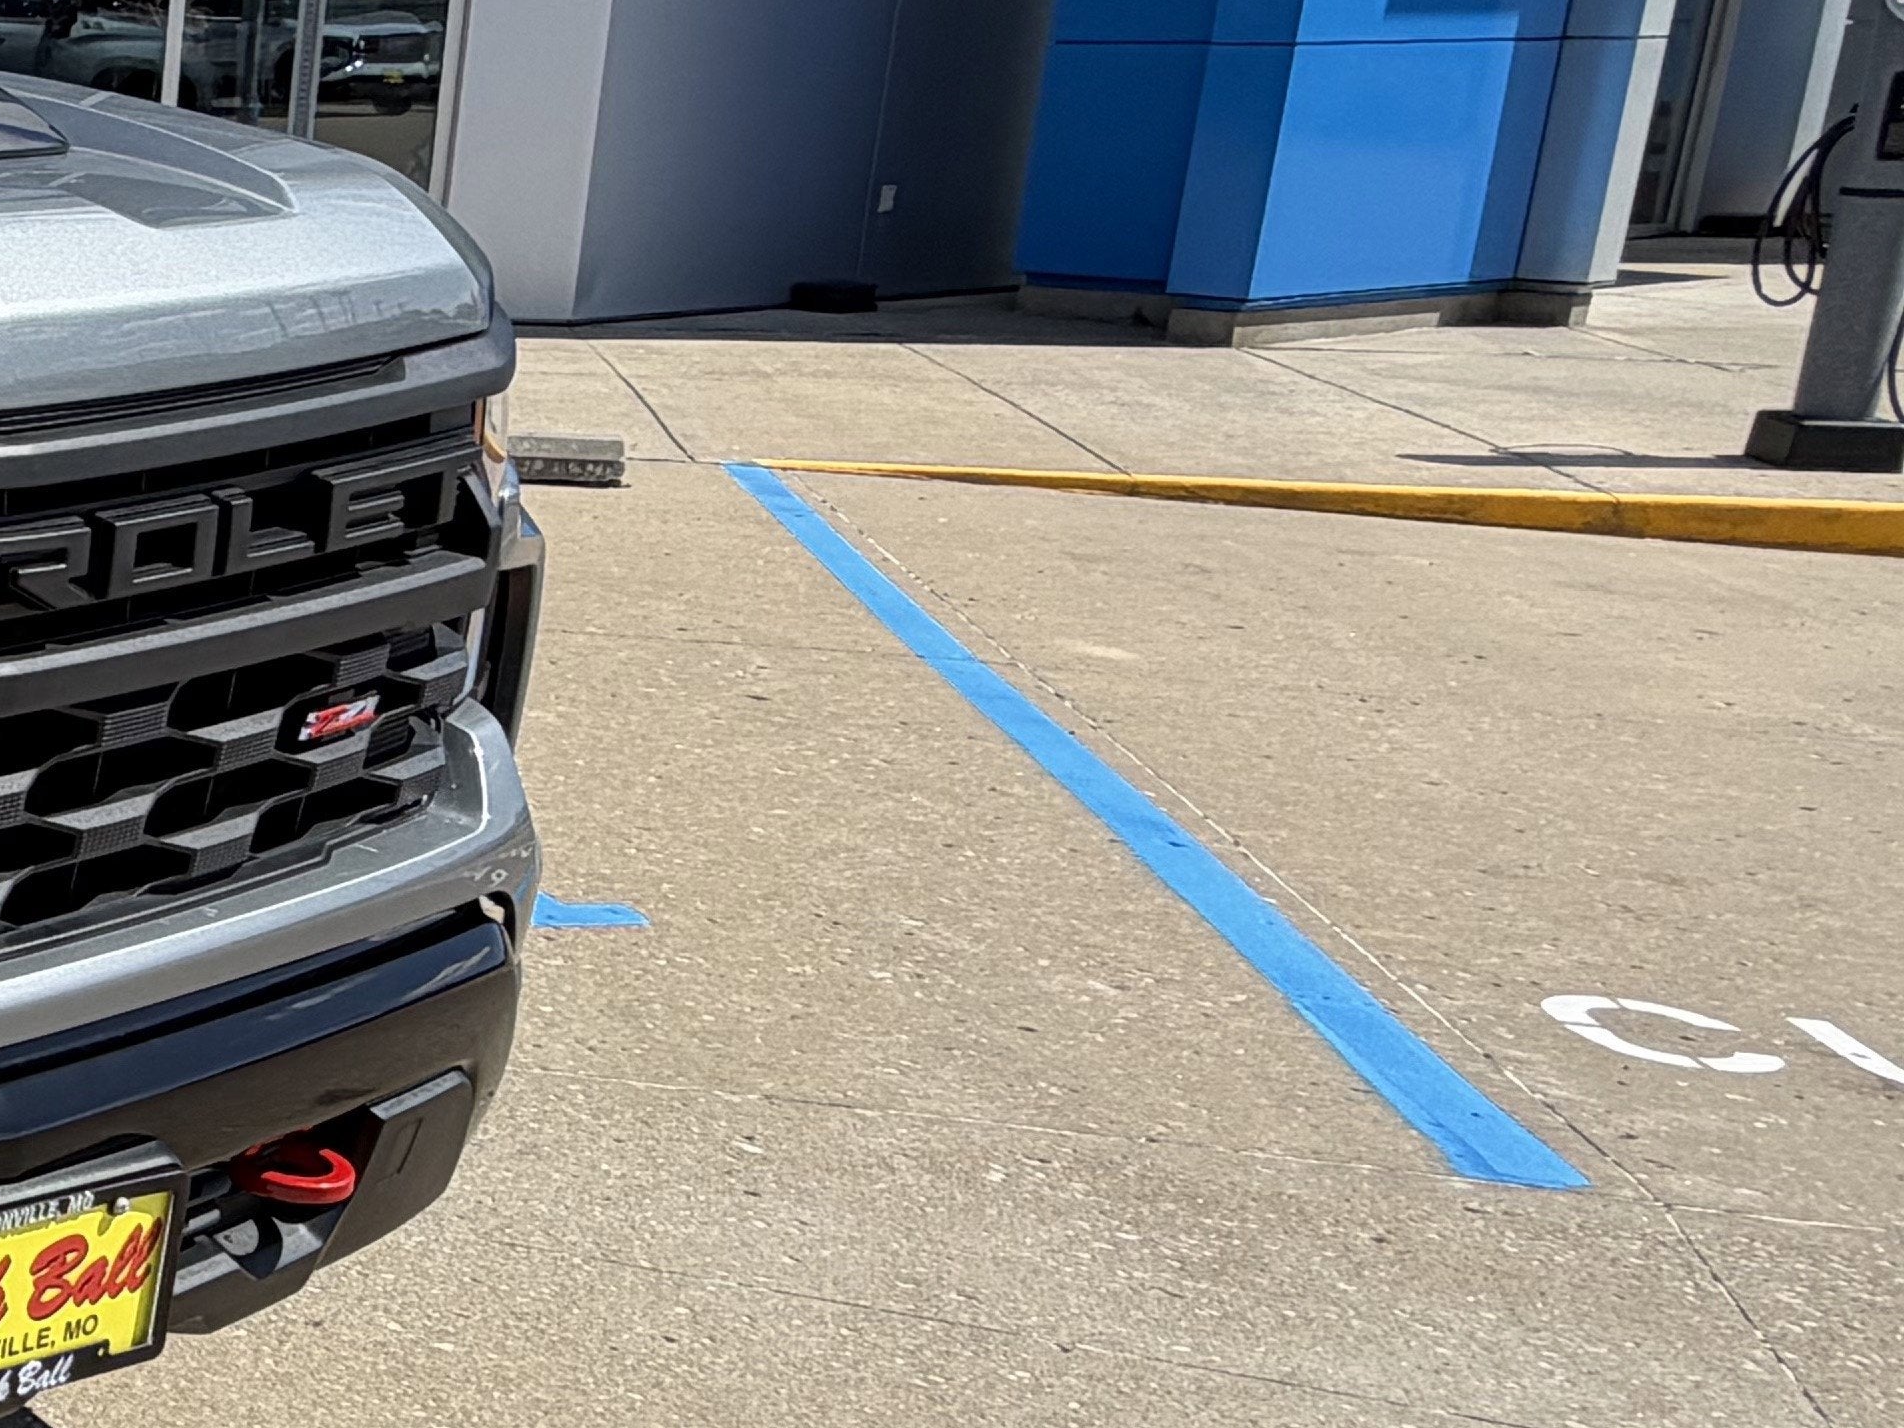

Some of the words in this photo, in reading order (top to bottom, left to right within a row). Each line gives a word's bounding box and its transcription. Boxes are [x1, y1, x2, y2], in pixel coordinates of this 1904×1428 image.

[66, 1190, 96, 1214] MO
[26, 1216, 164, 1322] Ball
[62, 1314, 100, 1341] MO
[16, 1354, 75, 1398] Ball
